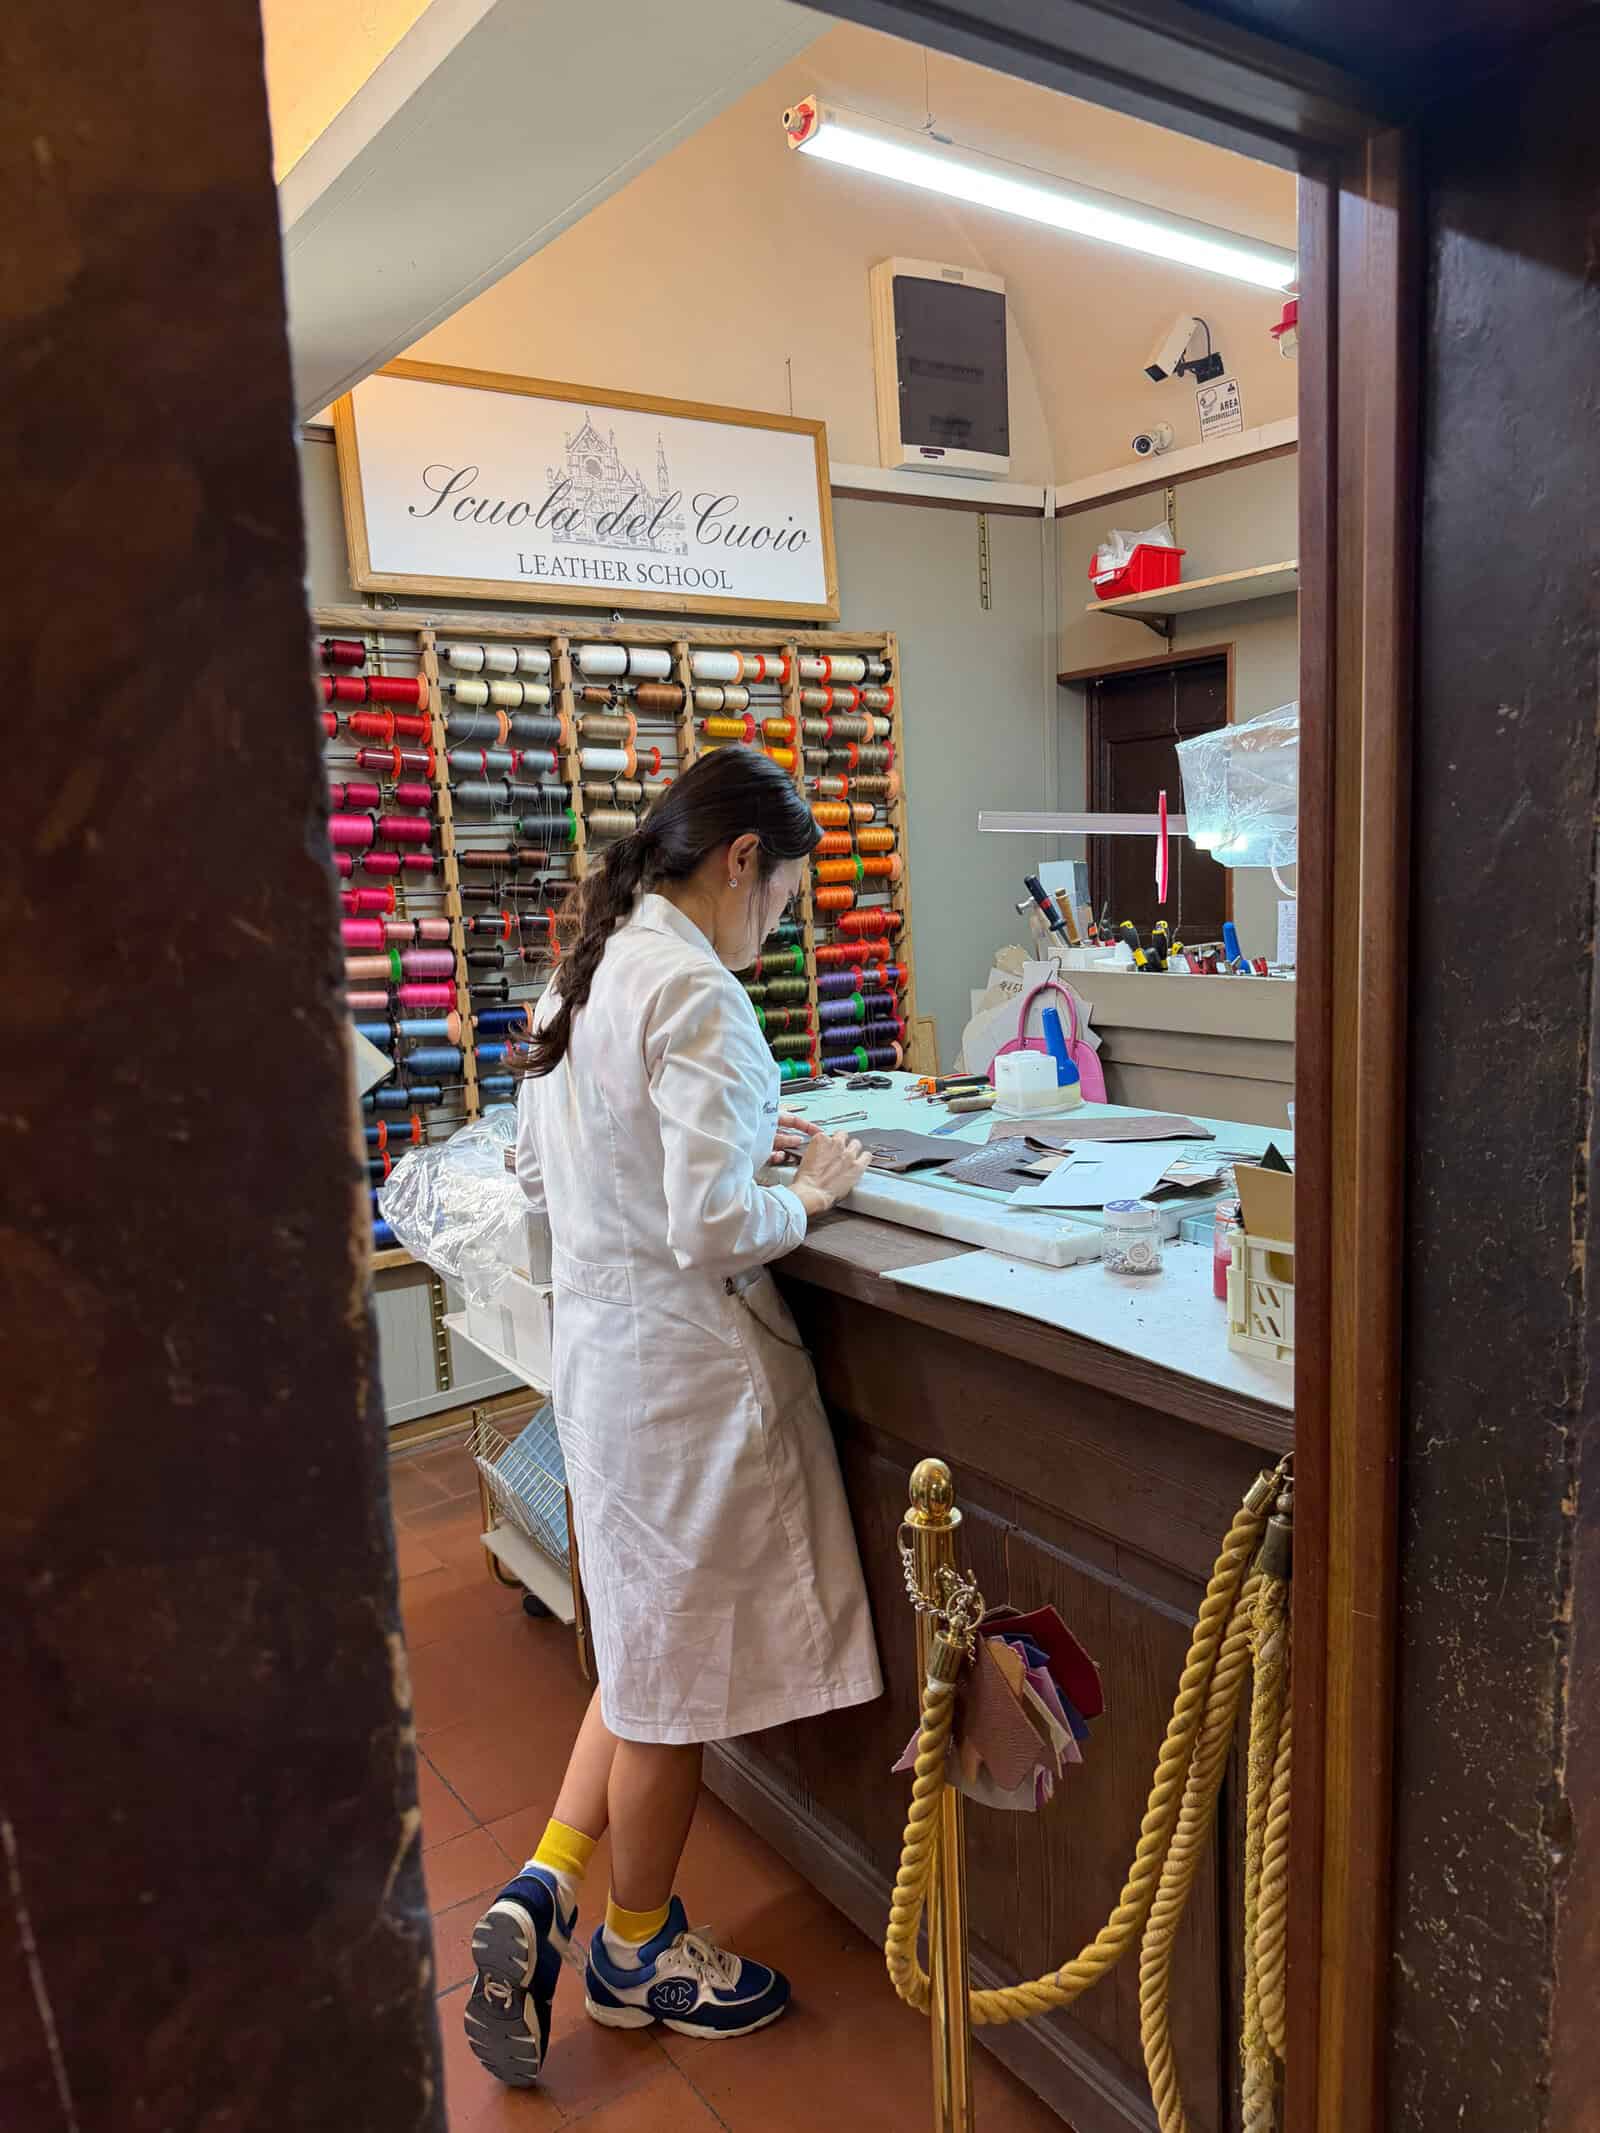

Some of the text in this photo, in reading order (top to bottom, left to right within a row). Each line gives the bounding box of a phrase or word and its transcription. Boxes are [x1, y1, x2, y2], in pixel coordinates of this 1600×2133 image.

[1220, 397, 1238, 411] AREA
[408, 464, 811, 552] Scuola del Cuoio
[517, 553, 735, 590] LEATHER SCHOOL
